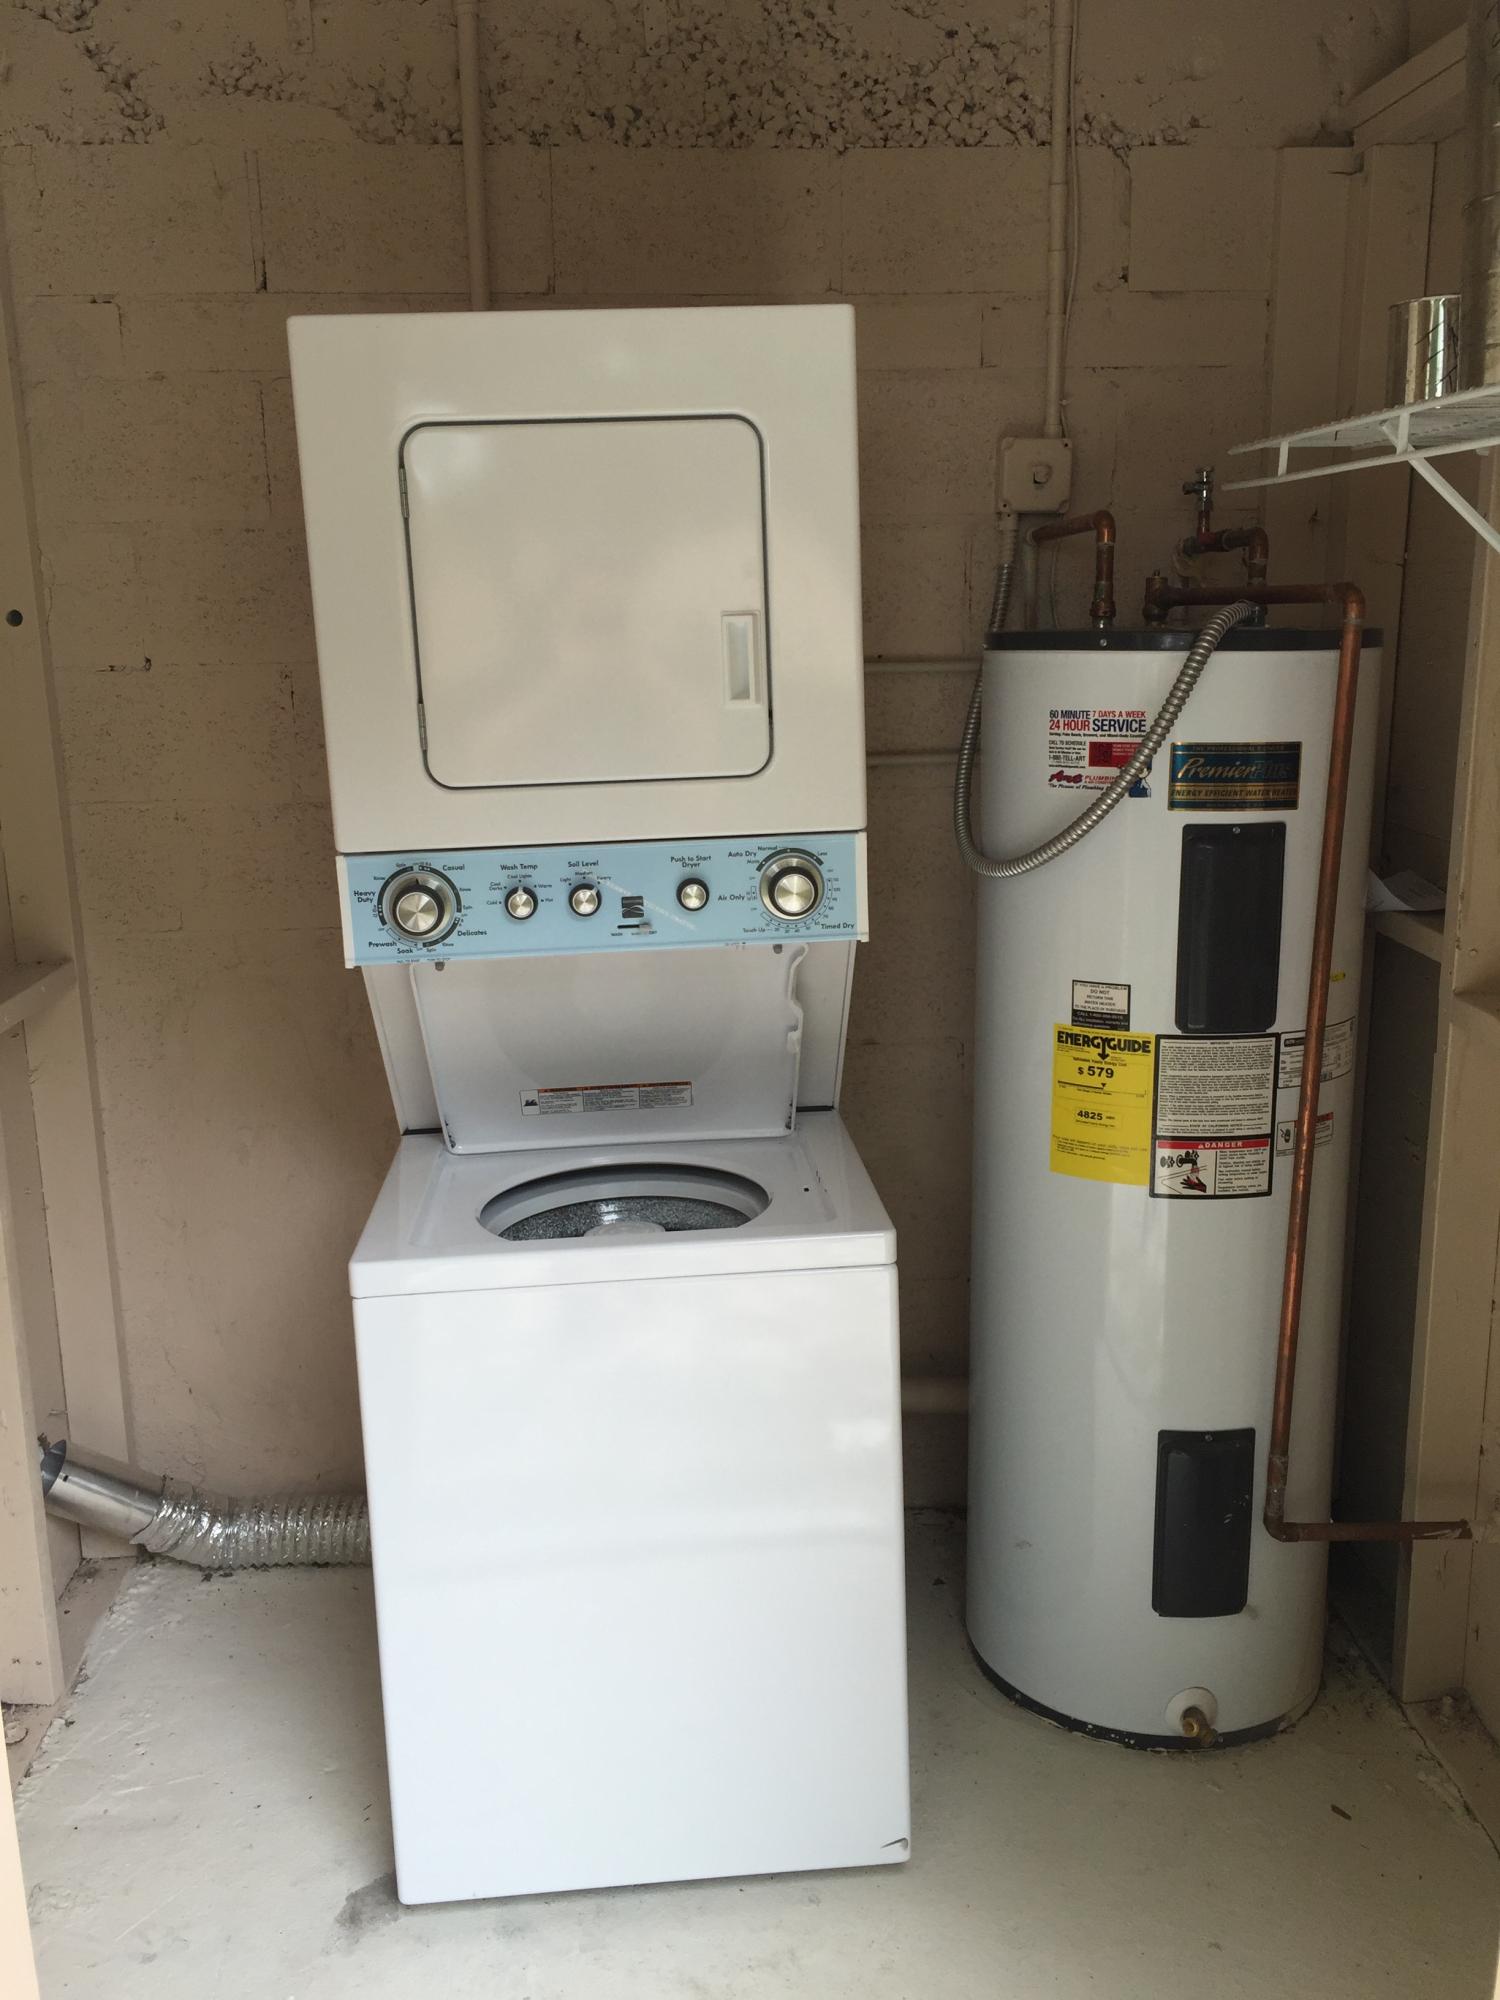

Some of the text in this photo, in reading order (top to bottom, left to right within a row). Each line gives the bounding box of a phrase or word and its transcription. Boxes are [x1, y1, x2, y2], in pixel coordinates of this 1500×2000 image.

[1049, 709, 1147, 720] 60 MINUTE 7 DAYS A WEEK
[1049, 718, 1147, 732] 24 HOUR SERVICE
[745, 850, 757, 858] Dry
[442, 863, 466, 871] Casual
[568, 859, 599, 868] Soil Level
[682, 861, 701, 869] Dryer
[353, 890, 376, 898] Heavy
[729, 894, 745, 902] Only
[357, 896, 374, 904] Duty
[842, 922, 855, 930] Dry
[457, 929, 488, 938] Delicates
[368, 940, 397, 949] Prewash
[397, 946, 414, 955] Soak
[1078, 1065, 1114, 1079] $ 579
[1077, 1109, 1103, 1121] 4825
[1205, 1141, 1243, 1149] DANGER
